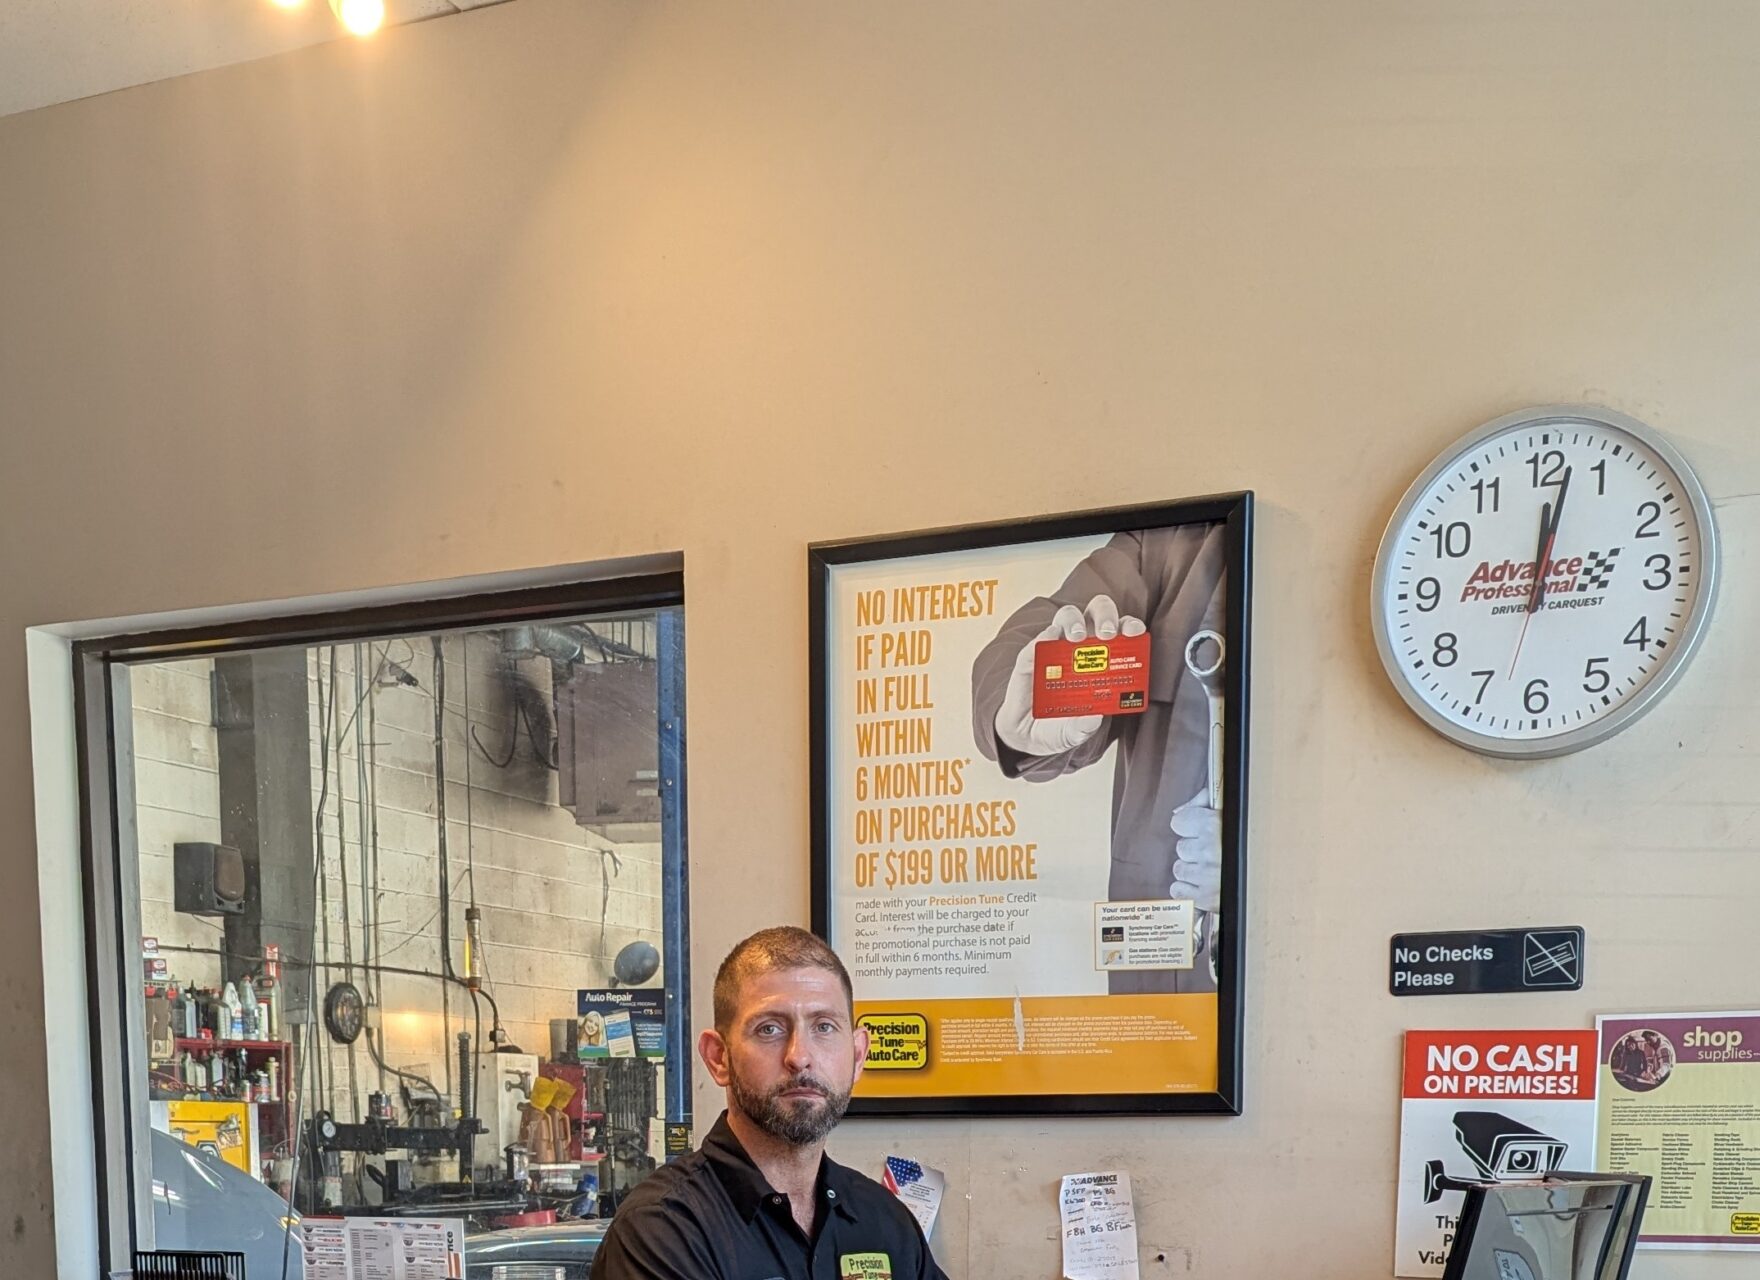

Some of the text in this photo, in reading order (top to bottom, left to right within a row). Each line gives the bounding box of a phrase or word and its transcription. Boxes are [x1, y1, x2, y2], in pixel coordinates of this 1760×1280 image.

[1526, 450, 1566, 488] 12
[1590, 458, 1606, 496] 1
[1470, 476, 1500, 514] 11
[1634, 501, 1662, 538] 2
[1430, 522, 1471, 558] 10
[1642, 553, 1672, 590] 3
[1416, 576, 1441, 612] 9
[1460, 576, 1578, 602] Professnal
[857, 580, 998, 626] NO INTEREST
[1548, 596, 1605, 610] CARQUEST
[1623, 616, 1652, 652] 4
[856, 630, 932, 671] IF PAID
[1077, 649, 1106, 657] Precision
[1432, 632, 1459, 668] 8
[1471, 670, 1496, 704] 7
[1582, 657, 1610, 693] 5
[856, 674, 934, 714] IN FULL
[1523, 678, 1550, 714] 6
[856, 718, 932, 758] WITHIN
[856, 766, 868, 801] 6
[856, 800, 1016, 844] ON PURCHASES
[856, 844, 1038, 890] OF $199 OR MORE
[856, 892, 1038, 910] made with your Precision Tune Credit
[855, 908, 1029, 923] Card. Interest will be charged to your
[918, 921, 1015, 936] the purchase date if
[855, 934, 1031, 952] the promotional purchase is not paid
[1396, 945, 1494, 964] No Checks
[855, 950, 1012, 964] in full within 6 months. Minimum
[855, 964, 990, 978] monthly payments required.
[1394, 971, 1454, 987] Please
[584, 992, 632, 1003] Auto Repair
[878, 1036, 905, 1047] Tune
[1683, 1026, 1743, 1052] shop
[1427, 1044, 1579, 1072] NO CASH
[1697, 1046, 1753, 1062] supplies
[1424, 1074, 1579, 1094] ON PREMISES!
[1080, 1174, 1118, 1185] ADVANCE
[1435, 1216, 1460, 1229] Thi
[848, 1258, 884, 1270] Precision
[1418, 1250, 1450, 1264] Vid
[863, 1270, 878, 1279] Tune
